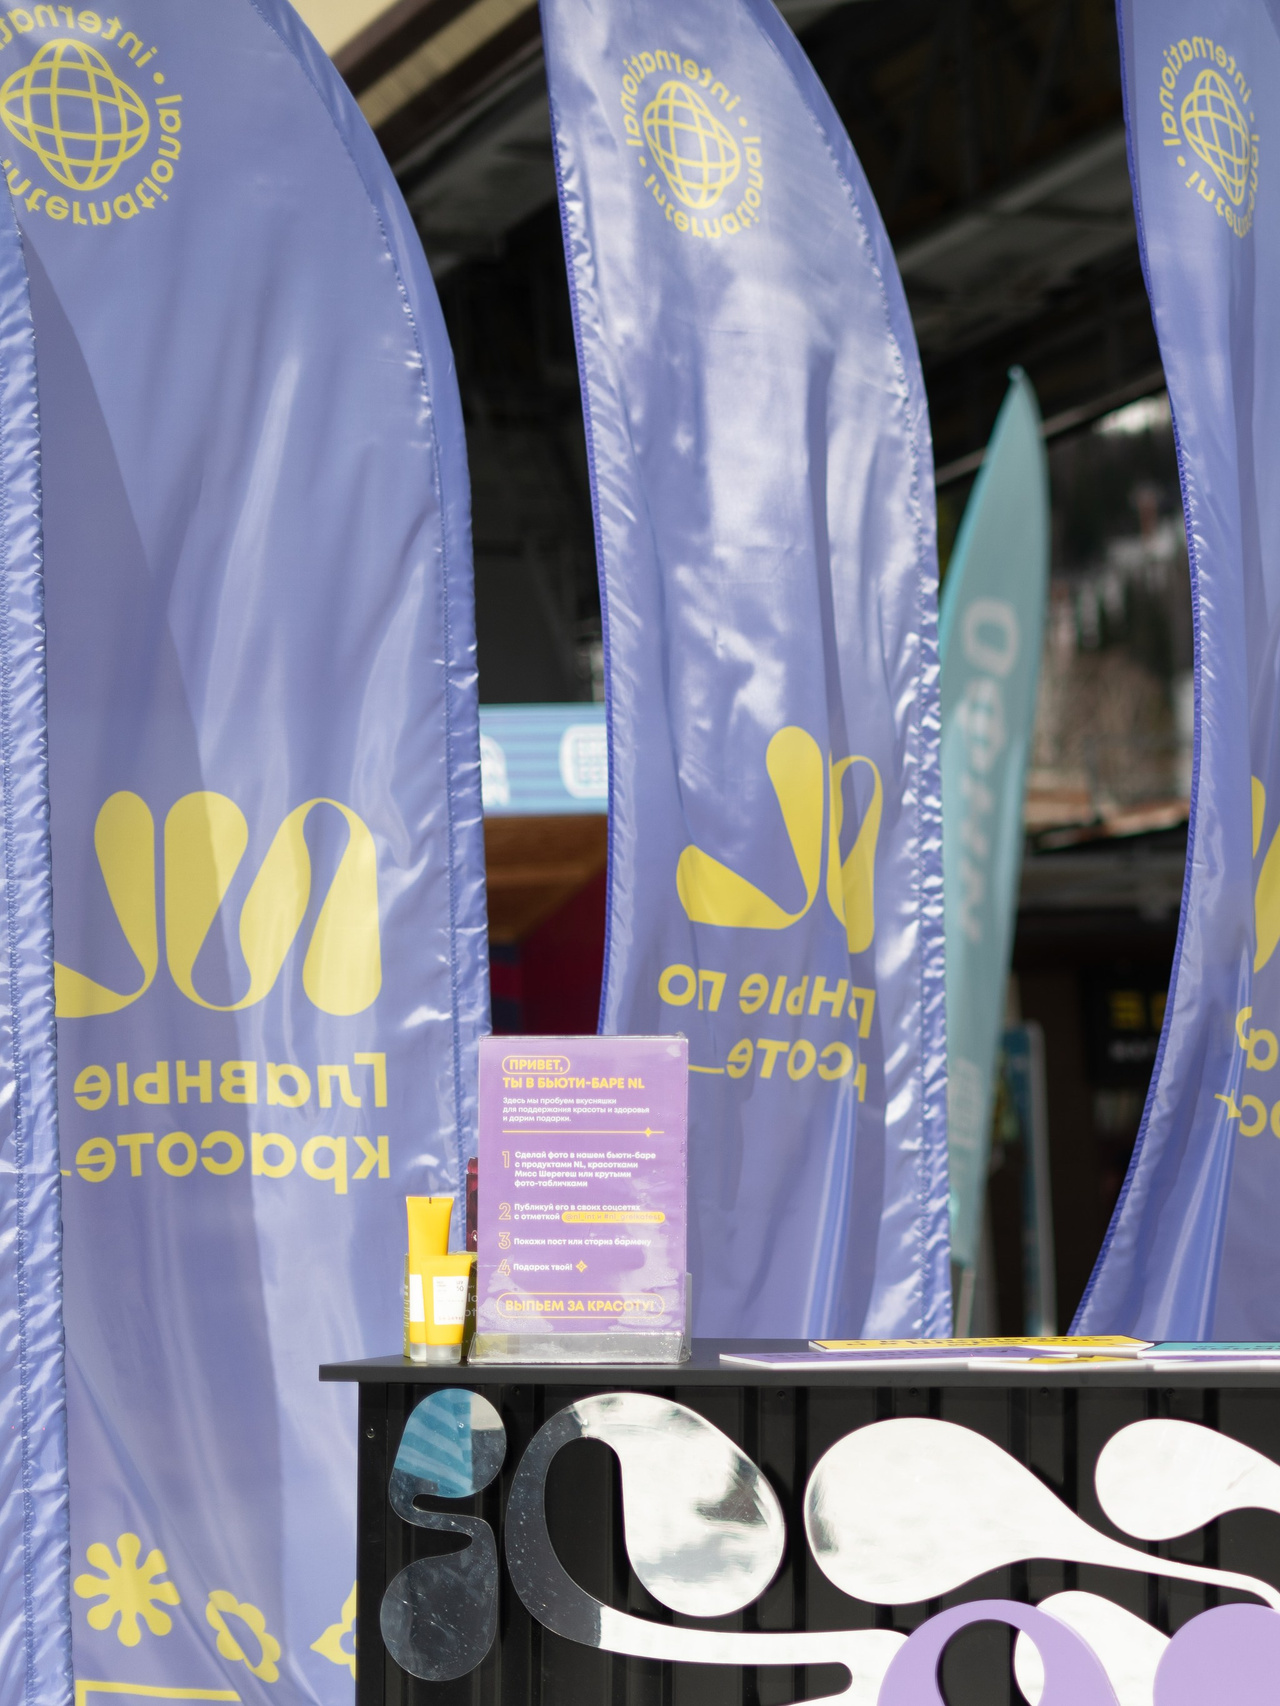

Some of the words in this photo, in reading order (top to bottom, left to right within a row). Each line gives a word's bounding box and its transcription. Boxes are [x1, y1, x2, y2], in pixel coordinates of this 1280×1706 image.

[509, 1059, 564, 1072] ПРИВЕТ,
[503, 1077, 523, 1089] ТЫ
[526, 1077, 534, 1089] В
[537, 1077, 625, 1089] БЬЮТИ-БАРЕ
[628, 1078, 645, 1089] NL
[503, 1097, 525, 1105] Здесь
[540, 1097, 574, 1106] пробуем
[576, 1098, 617, 1106] вкусняшки
[502, 1151, 510, 1168] 1
[515, 1151, 546, 1160] Сделай
[547, 1152, 569, 1160] фото
[606, 1151, 656, 1160] бьюти-баре
[521, 1162, 572, 1170] продуктами
[574, 1161, 586, 1169] NL,
[588, 1162, 638, 1170] красотками
[539, 1171, 577, 1179] Шерегеш
[514, 1179, 588, 1188] фото-табличками
[499, 1202, 511, 1221] 2
[514, 1203, 554, 1212] Публикуй
[498, 1232, 511, 1249] 3
[614, 1238, 651, 1247] бармену
[498, 1259, 511, 1276] 4
[513, 1263, 550, 1272] Подарок
[551, 1263, 573, 1271] твой!
[505, 1300, 565, 1312] ВЫПЬЕМ
[567, 1300, 585, 1312] ЗА
[587, 1300, 654, 1312] КРАСОТУ!
